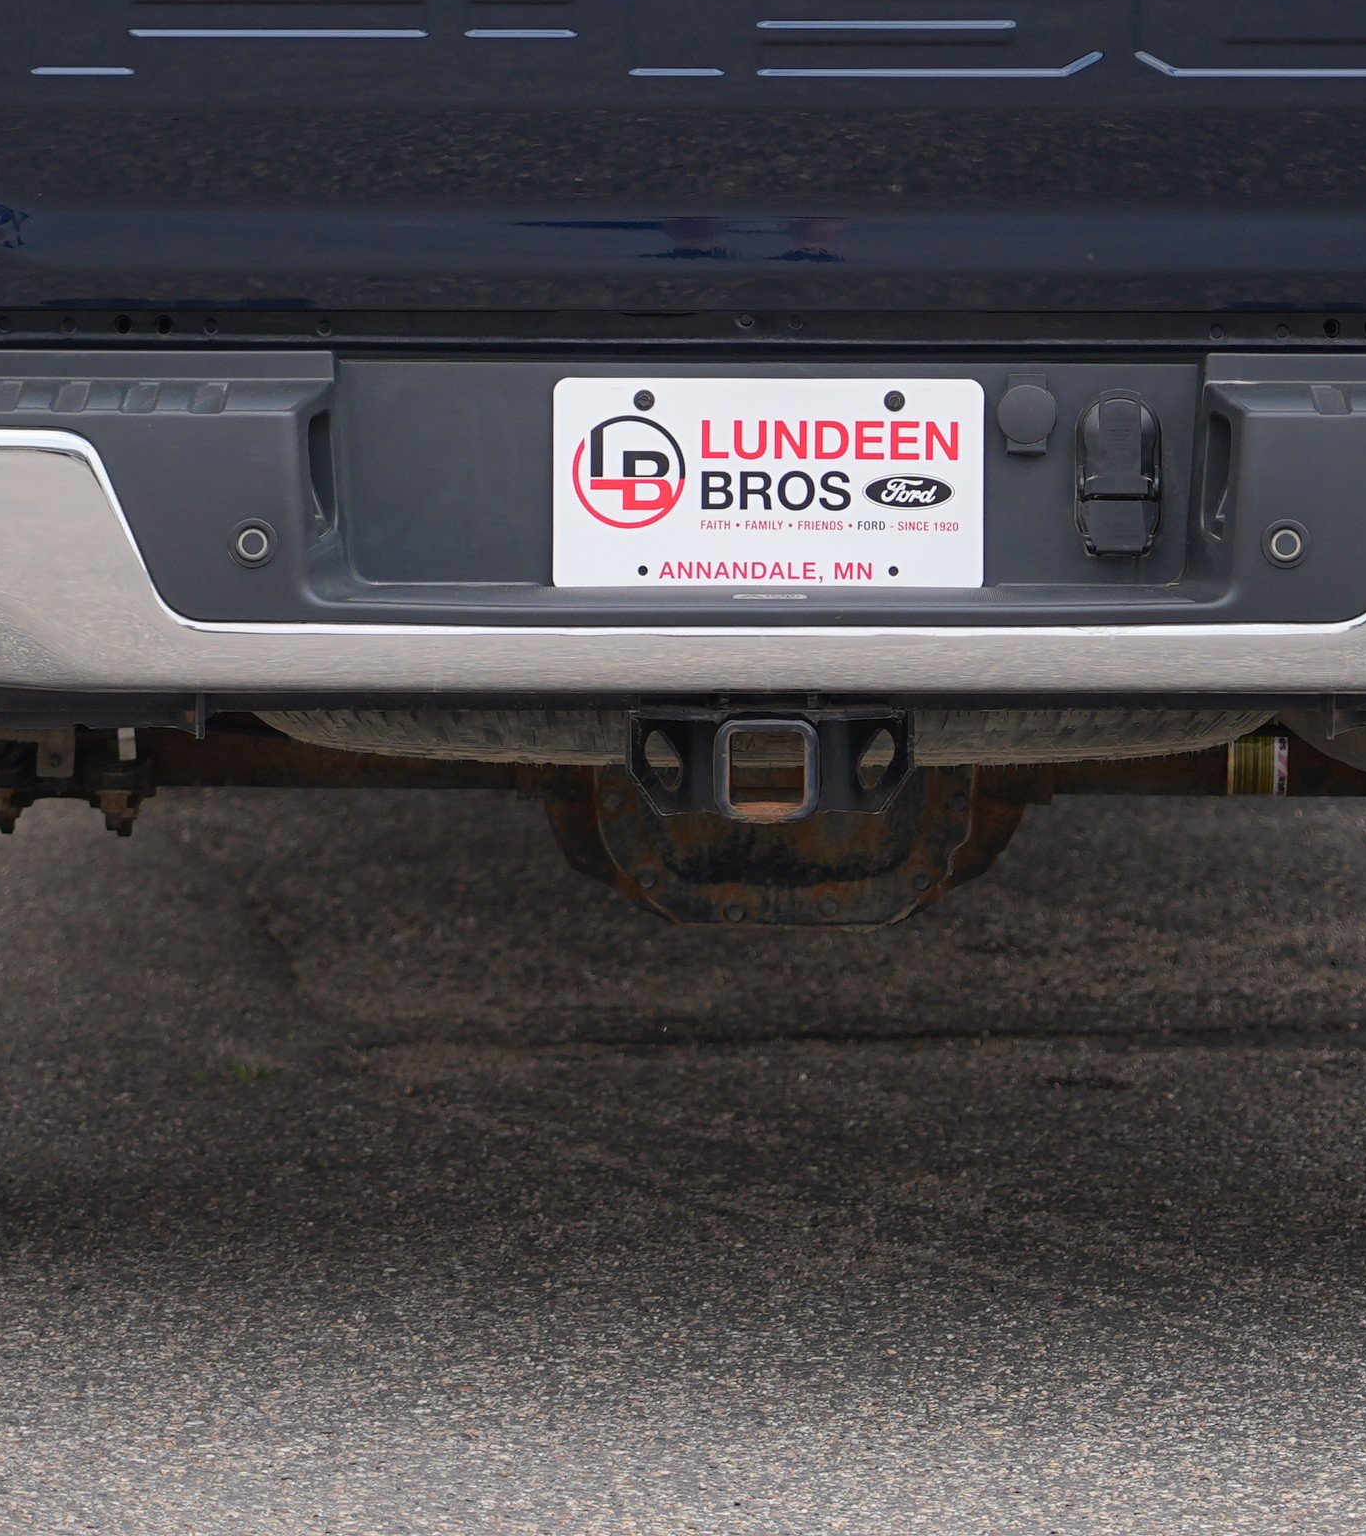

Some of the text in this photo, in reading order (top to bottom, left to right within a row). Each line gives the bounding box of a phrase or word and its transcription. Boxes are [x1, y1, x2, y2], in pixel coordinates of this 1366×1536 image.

[700, 419, 960, 461] LUNDEEN
[700, 470, 939, 512] BROS Ford
[700, 519, 960, 532] FAITH FAMILY FRIENDS FORD SINCE 1920
[658, 561, 874, 584] ANNANDALE, MN
